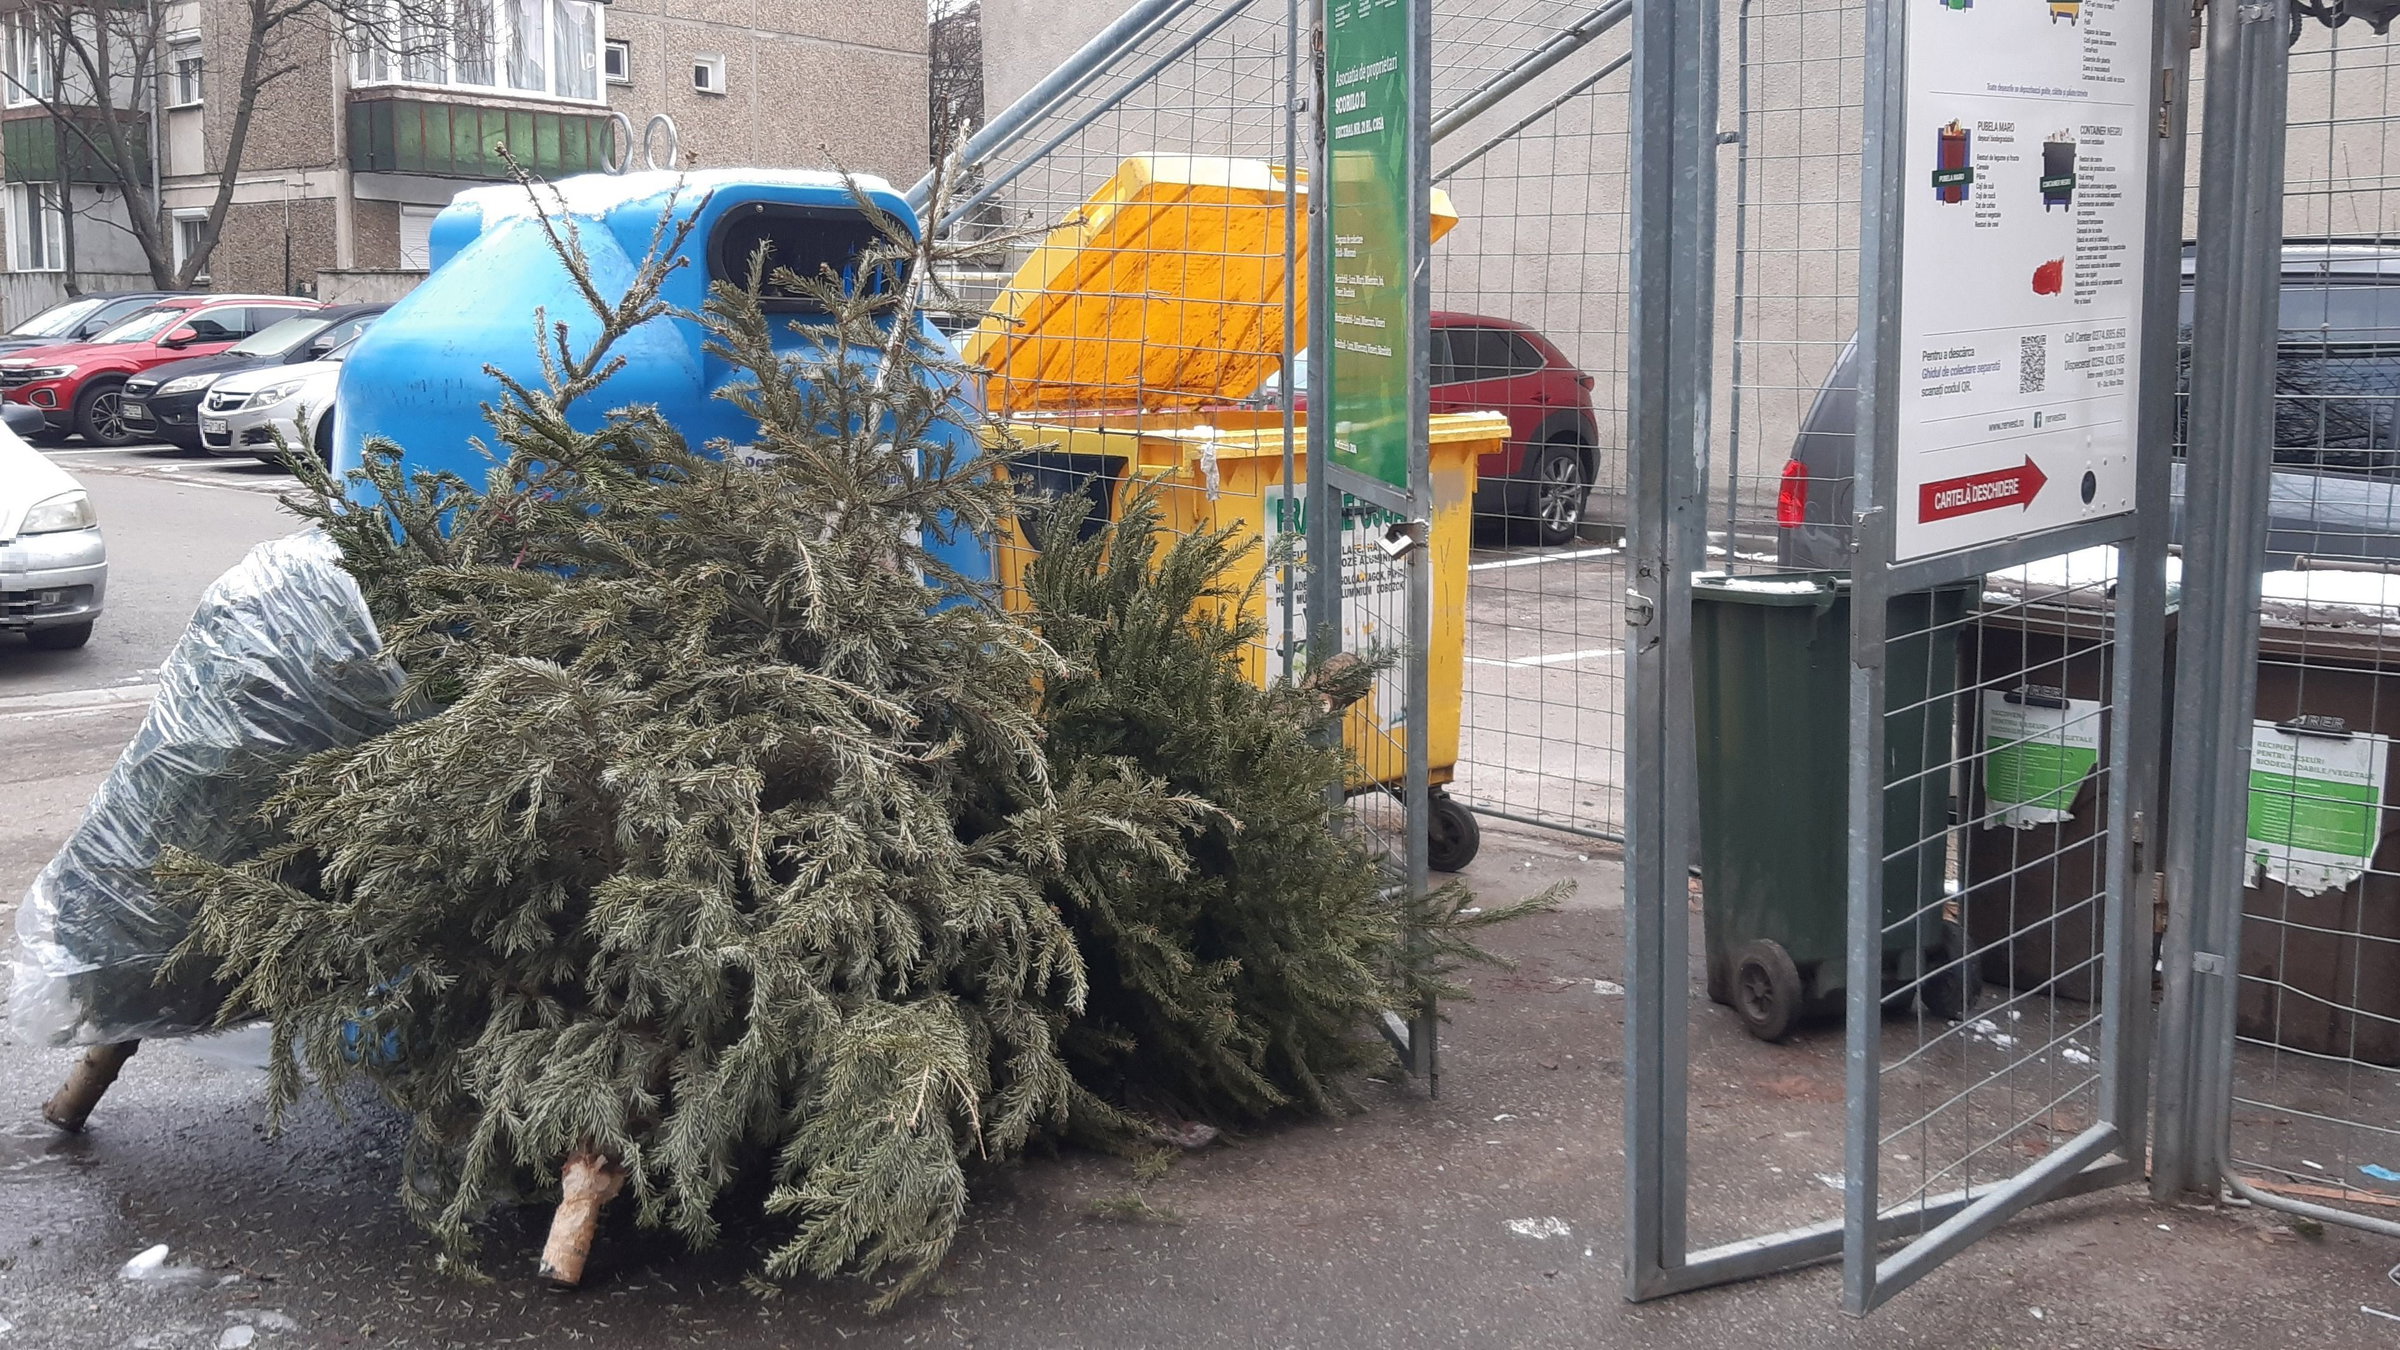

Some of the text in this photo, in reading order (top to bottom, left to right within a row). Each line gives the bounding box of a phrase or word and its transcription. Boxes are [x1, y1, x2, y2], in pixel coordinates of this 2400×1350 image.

[1358, 63, 1366, 80] de
[1366, 51, 1398, 83] proprietari
[1977, 121, 2015, 132] PUBELA MARO
[2080, 125, 2106, 136] CONTAINER
[2064, 331, 2074, 343] Call
[2075, 331, 2091, 342] Center
[1922, 346, 1975, 361] Pentru a descărca
[1922, 360, 2001, 379] Ghidul de colectare separată
[1921, 383, 1943, 398] scanați
[1944, 381, 1960, 394] codul
[1934, 477, 2019, 510] CARTELĂ DESCHIDERE
[2308, 714, 2345, 729] RER
